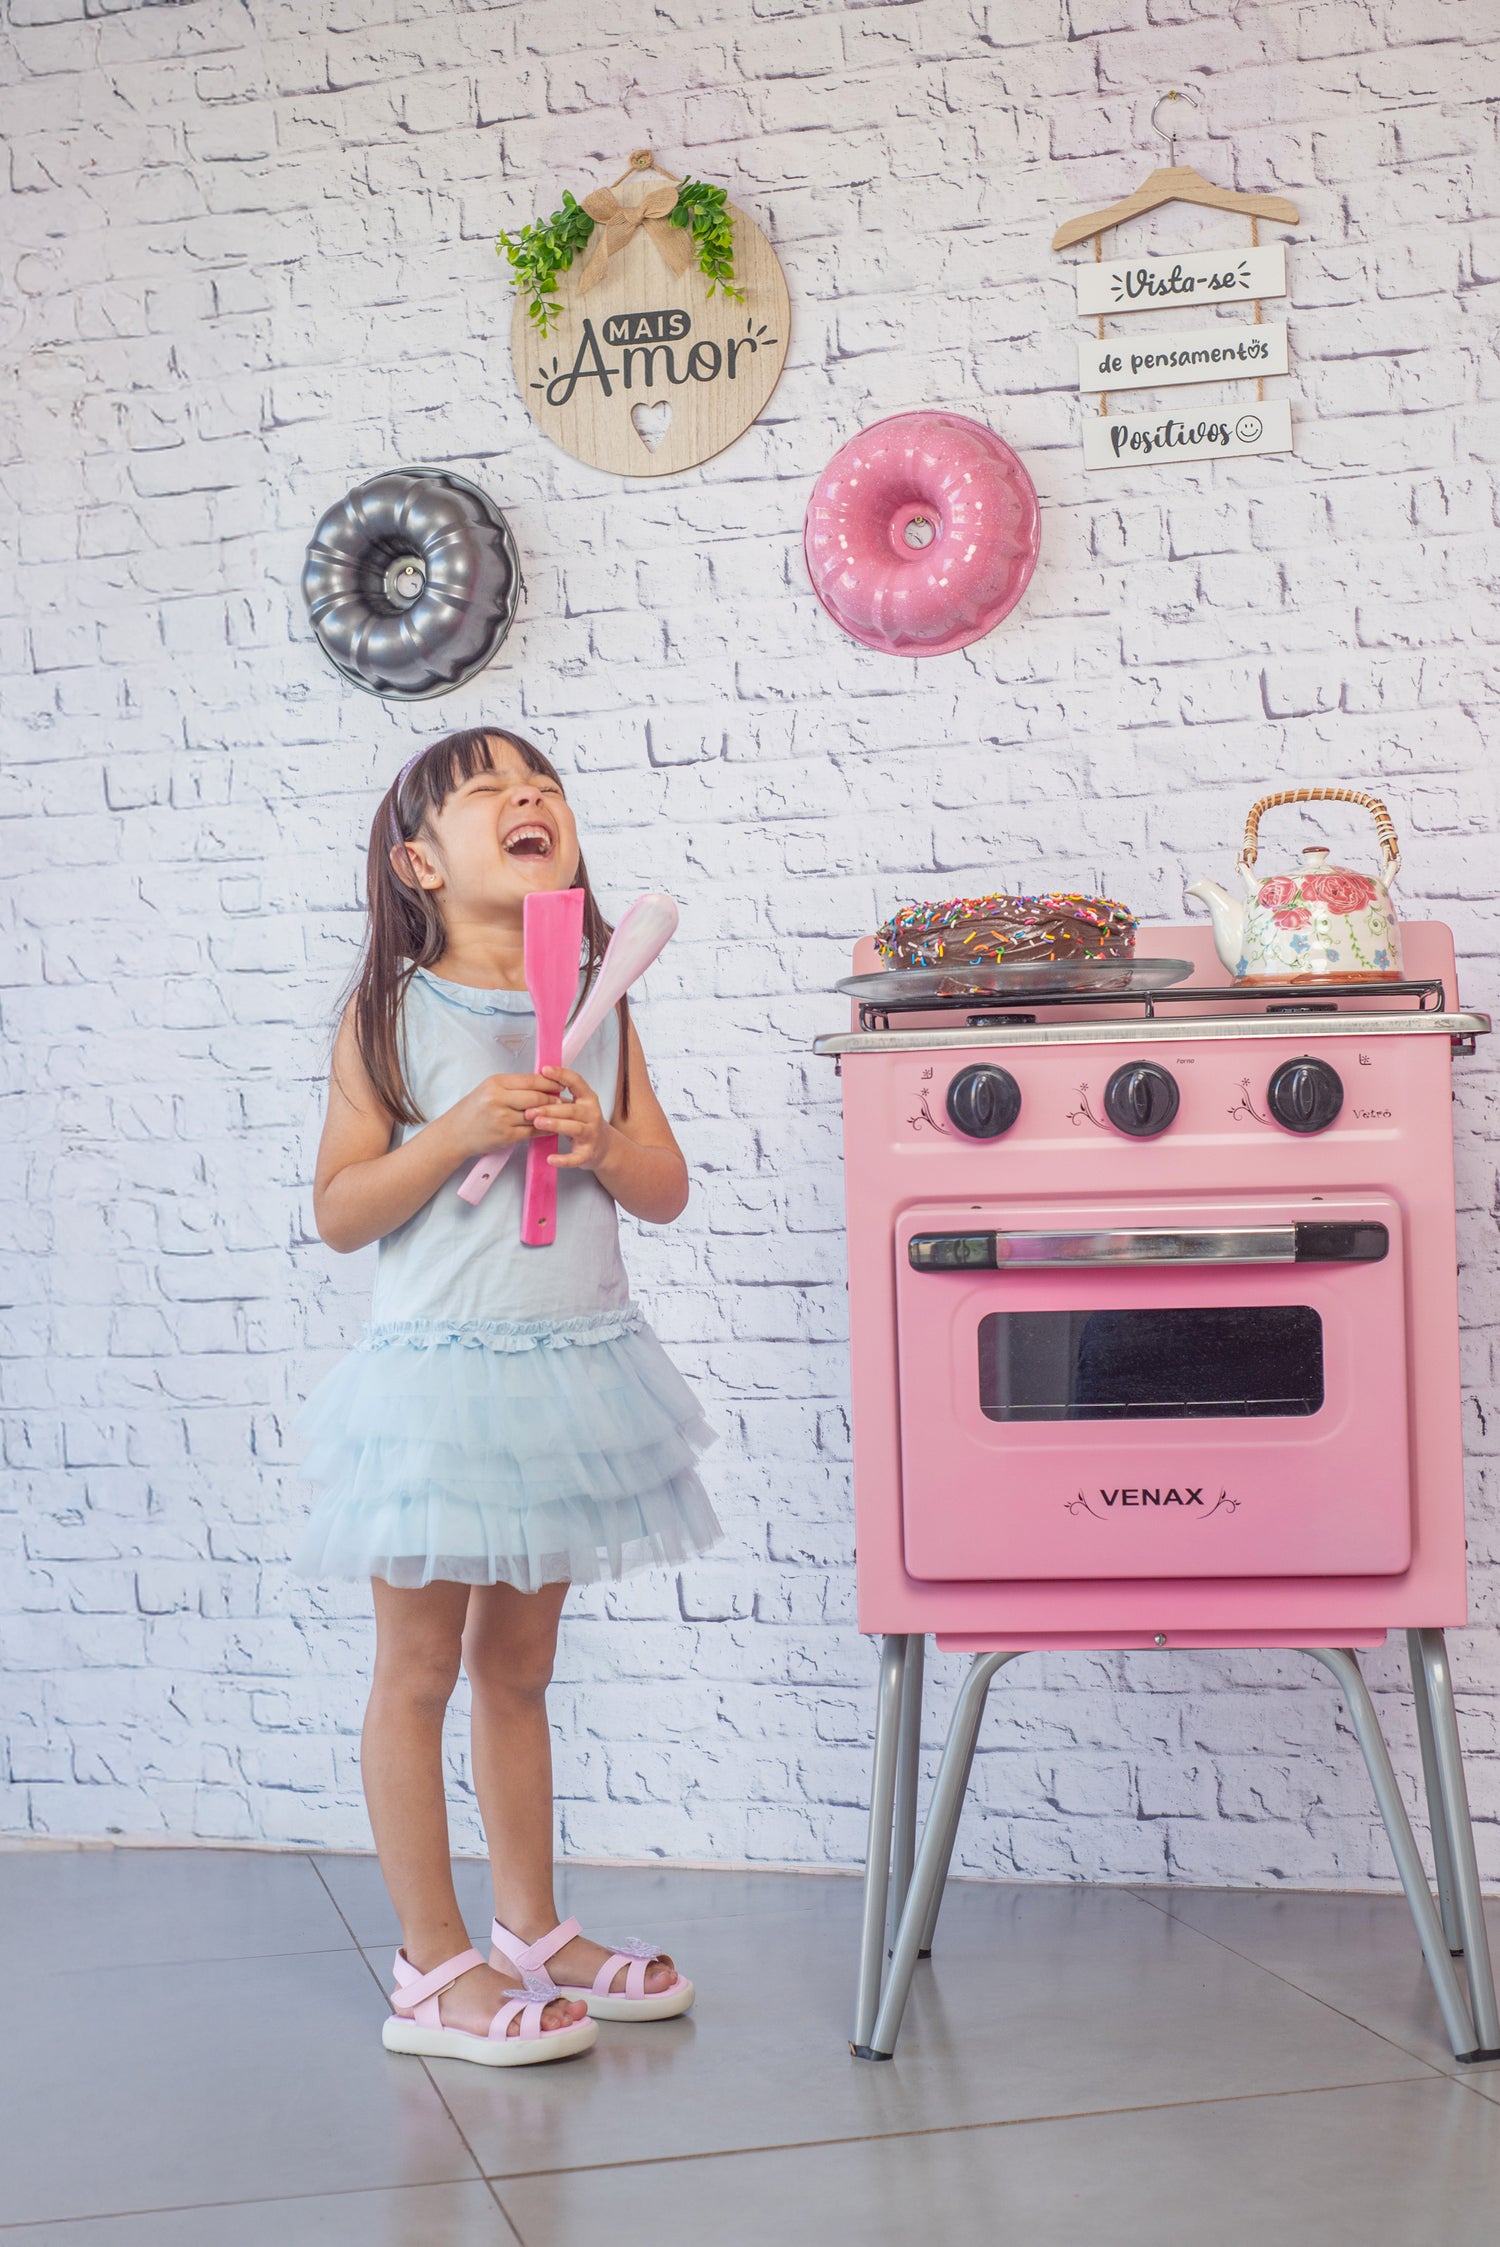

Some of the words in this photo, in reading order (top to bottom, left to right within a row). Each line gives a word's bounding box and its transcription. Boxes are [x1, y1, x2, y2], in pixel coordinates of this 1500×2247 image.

[1126, 264, 1236, 298] Vista-se
[609, 314, 685, 341] MAIS
[546, 318, 757, 406] Amor
[1099, 354, 1123, 374] de
[1131, 339, 1269, 375] pensamentos
[1110, 419, 1233, 458] Positivos
[1099, 1487, 1204, 1506] VENAX
